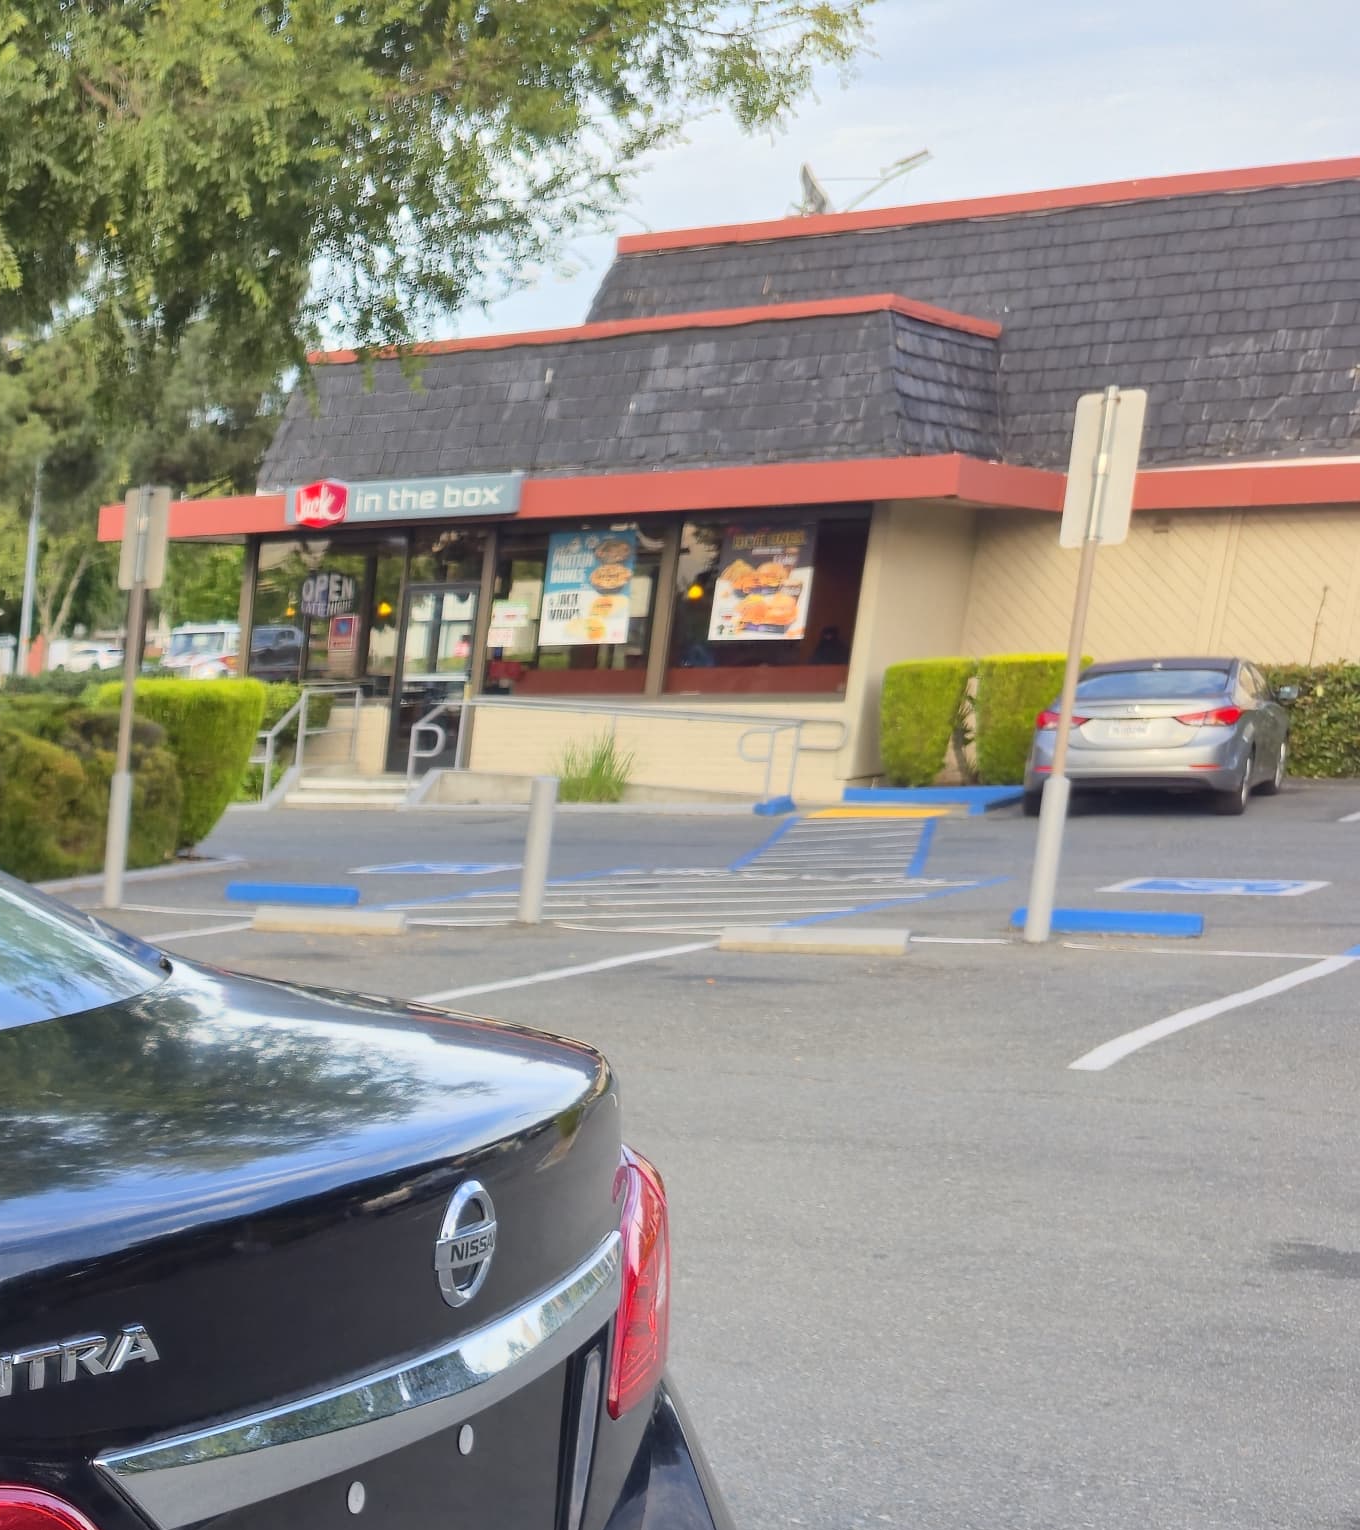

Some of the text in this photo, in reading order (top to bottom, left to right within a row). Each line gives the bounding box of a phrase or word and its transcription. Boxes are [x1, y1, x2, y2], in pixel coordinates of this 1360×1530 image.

[296, 484, 502, 522] Jack in the box
[301, 573, 354, 601] OPEN
[449, 1231, 495, 1263] NISSA
